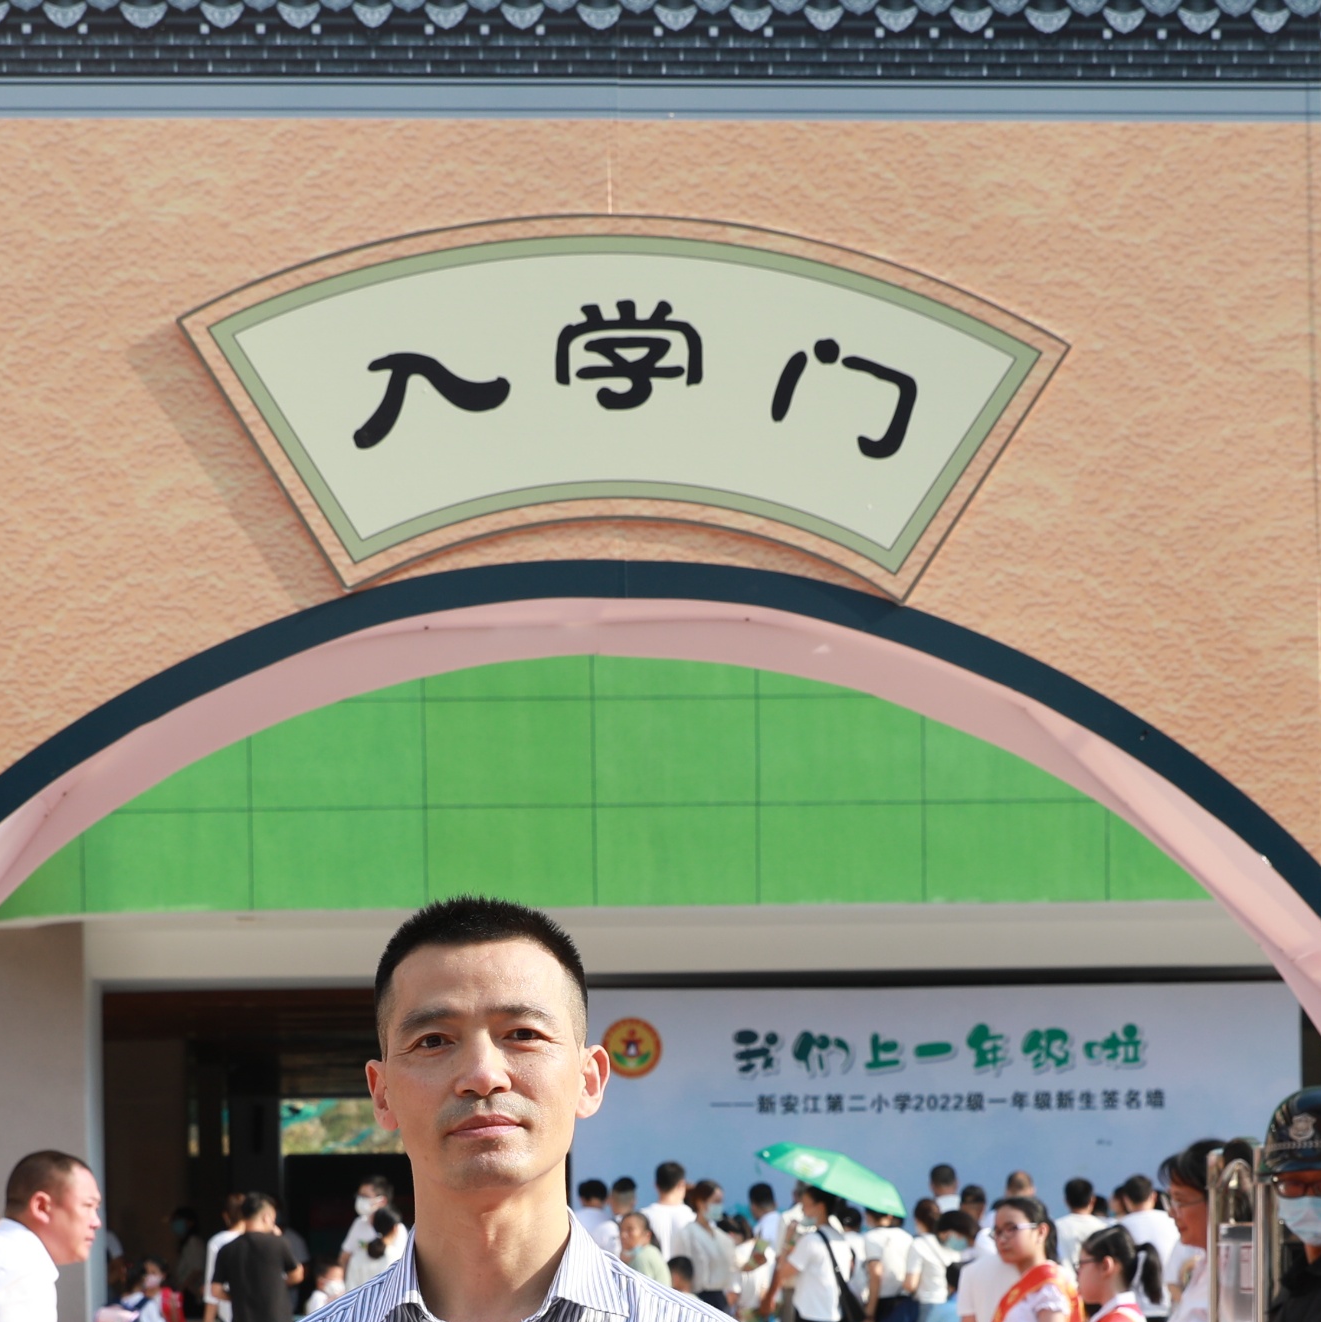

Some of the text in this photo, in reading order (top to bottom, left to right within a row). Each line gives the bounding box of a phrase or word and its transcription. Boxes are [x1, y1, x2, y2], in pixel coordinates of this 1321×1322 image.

[352, 299, 918, 459] 入学门
[733, 1023, 1144, 1075] 我们上一年级啦
